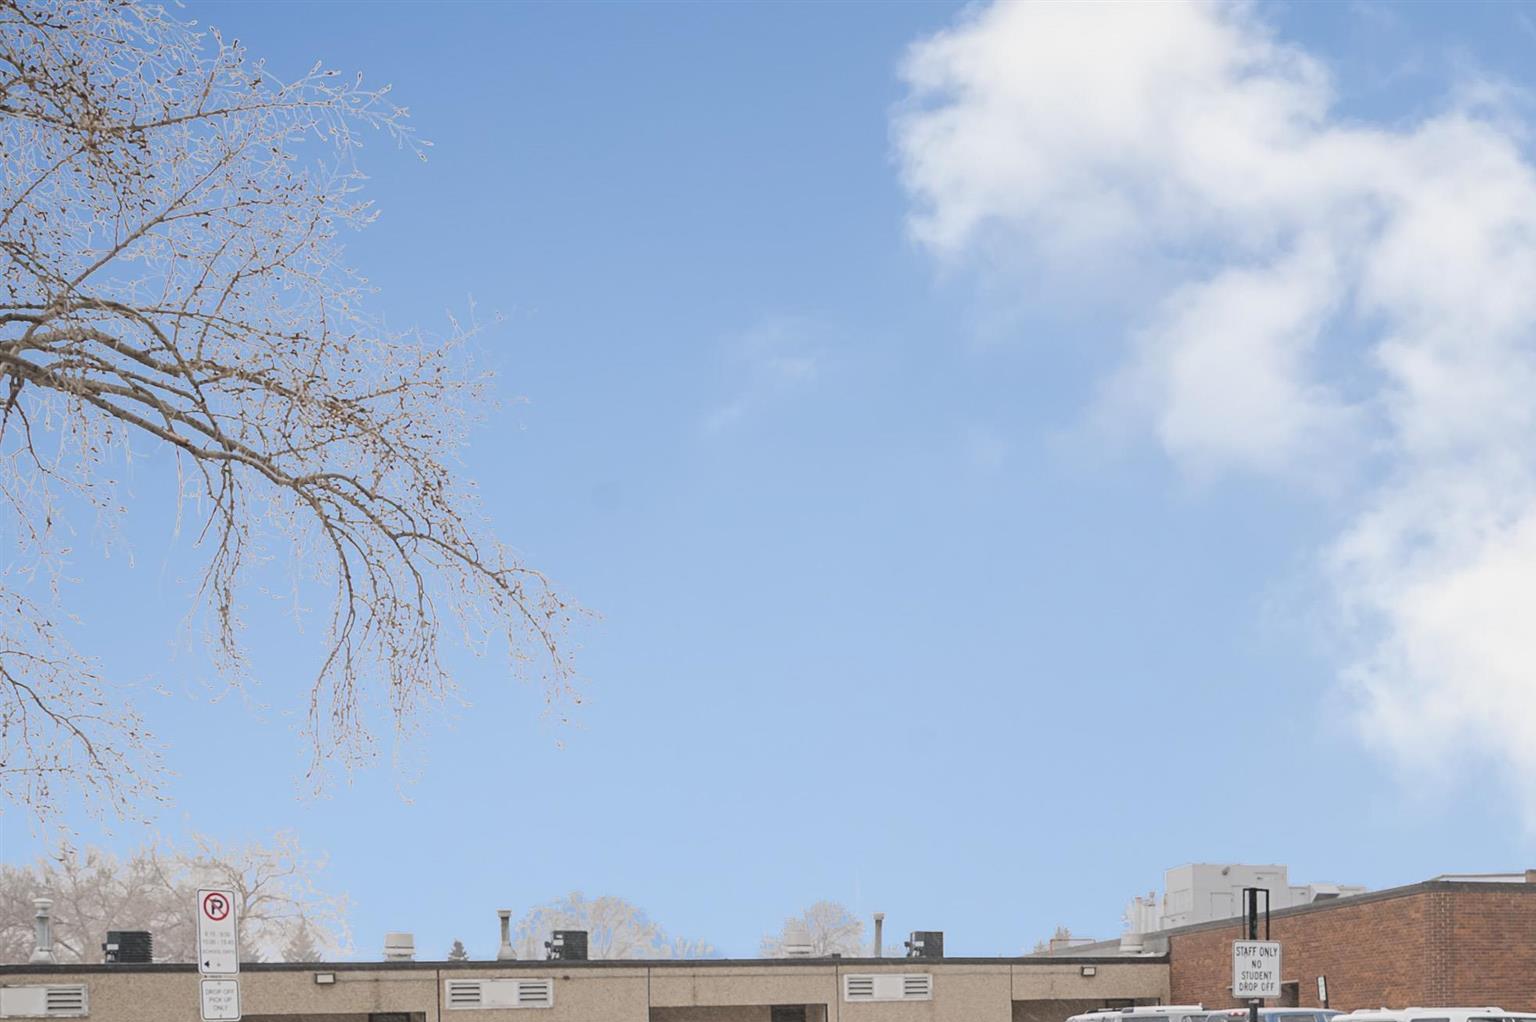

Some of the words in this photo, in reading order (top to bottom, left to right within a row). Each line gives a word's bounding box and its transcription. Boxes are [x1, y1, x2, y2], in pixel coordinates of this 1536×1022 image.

[1236, 946, 1256, 956] STAFF
[1259, 947, 1277, 957] ONLY
[1252, 960, 1262, 968] NO
[1241, 971, 1272, 980] STUDENT
[1239, 982, 1258, 991] DROP
[1261, 982, 1274, 991] OFF
